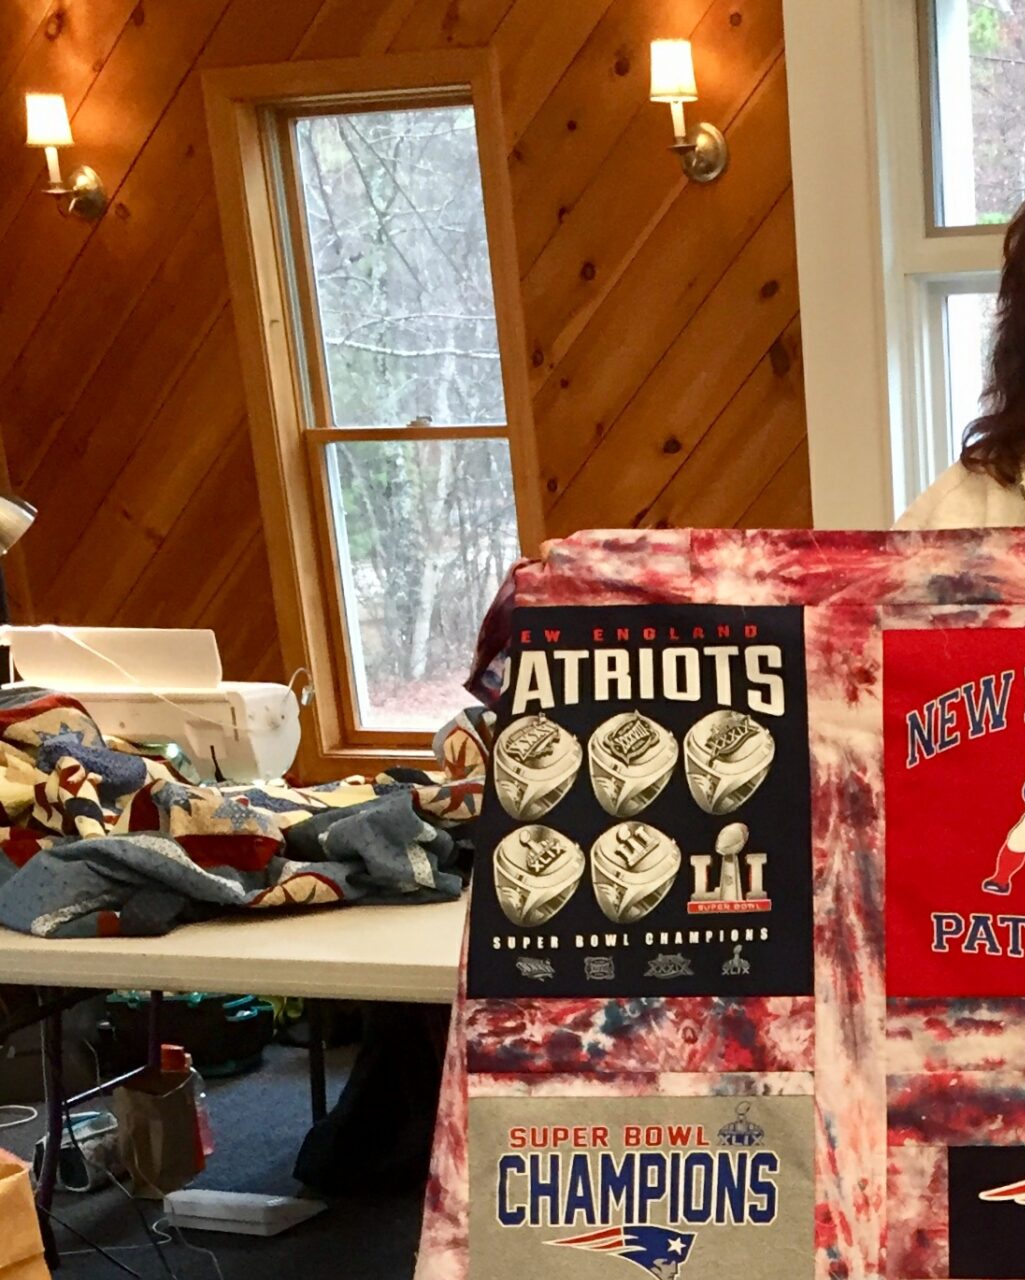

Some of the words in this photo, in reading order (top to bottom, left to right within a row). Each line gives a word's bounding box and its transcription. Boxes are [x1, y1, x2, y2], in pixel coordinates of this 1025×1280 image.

[520, 630, 561, 643] EW
[593, 625, 757, 642] ENGLAND
[906, 670, 1015, 769] NEW
[493, 936, 559, 949] SUPER
[575, 934, 629, 948] BOWL
[645, 927, 768, 945] CHAMPIONS
[510, 1126, 609, 1149] SUPER
[624, 1125, 711, 1147] BOWL
[716, 1134, 765, 1146] XLIX
[497, 1151, 780, 1227] CHAMPIONS
